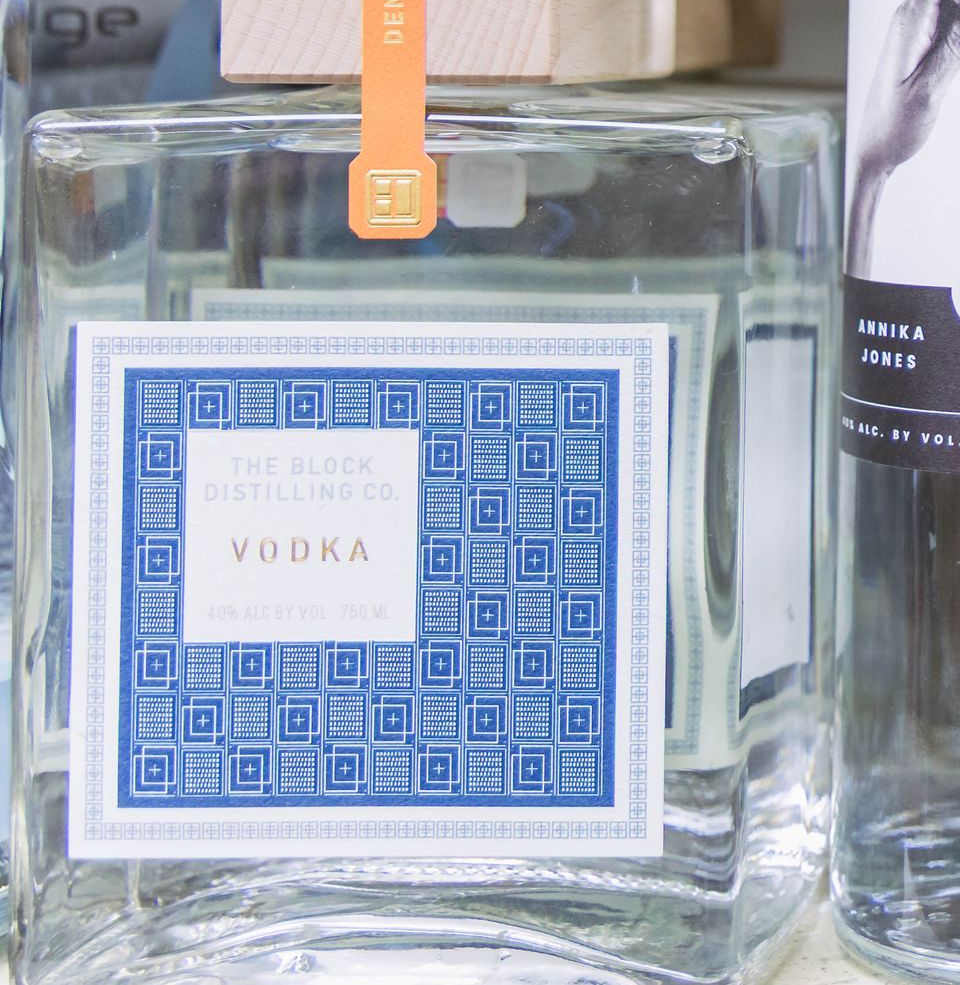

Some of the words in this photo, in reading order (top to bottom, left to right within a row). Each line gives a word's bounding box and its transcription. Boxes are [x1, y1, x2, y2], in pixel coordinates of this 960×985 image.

[858, 318, 926, 341] ANNIKA
[861, 348, 918, 370] JONES
[858, 422, 884, 438] ALC.
[893, 429, 910, 442] BY
[231, 457, 279, 476] THE
[291, 457, 374, 476] BLOCK
[204, 483, 353, 502] DISTILLING
[363, 483, 400, 501] CO.
[231, 536, 370, 564] VODKA
[207, 606, 239, 622] 40%
[244, 605, 271, 621] ALC
[275, 605, 294, 620] BY
[299, 605, 328, 620] VOL
[341, 604, 368, 620] 750
[372, 604, 391, 620] ML
